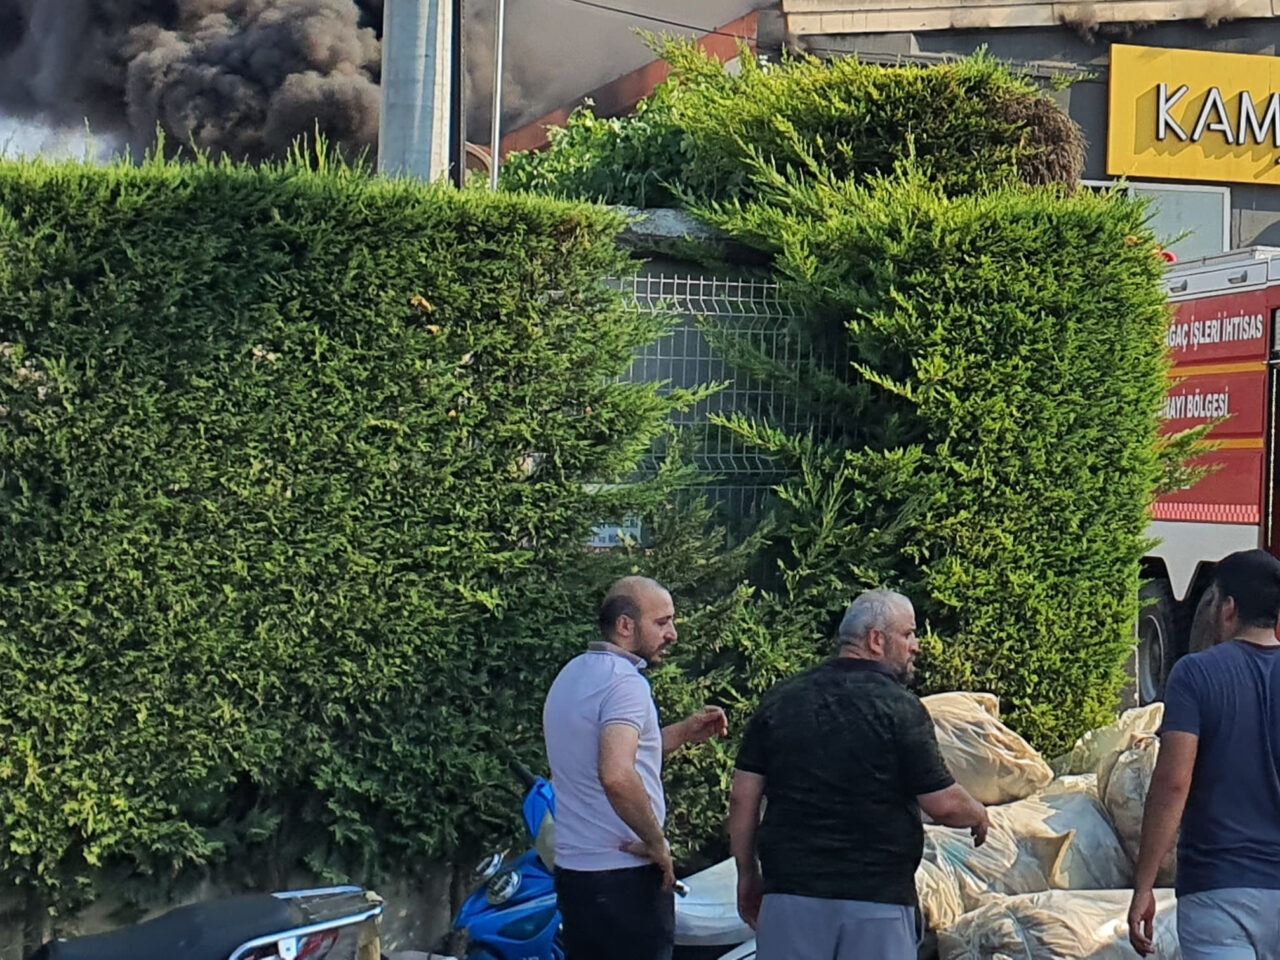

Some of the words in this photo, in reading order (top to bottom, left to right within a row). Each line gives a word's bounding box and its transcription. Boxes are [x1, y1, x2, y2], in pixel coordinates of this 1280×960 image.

[1189, 312, 1221, 351] İŞLERİ
[1222, 309, 1264, 342] İHTİSAS
[1186, 385, 1229, 418] BÖLGESİ
